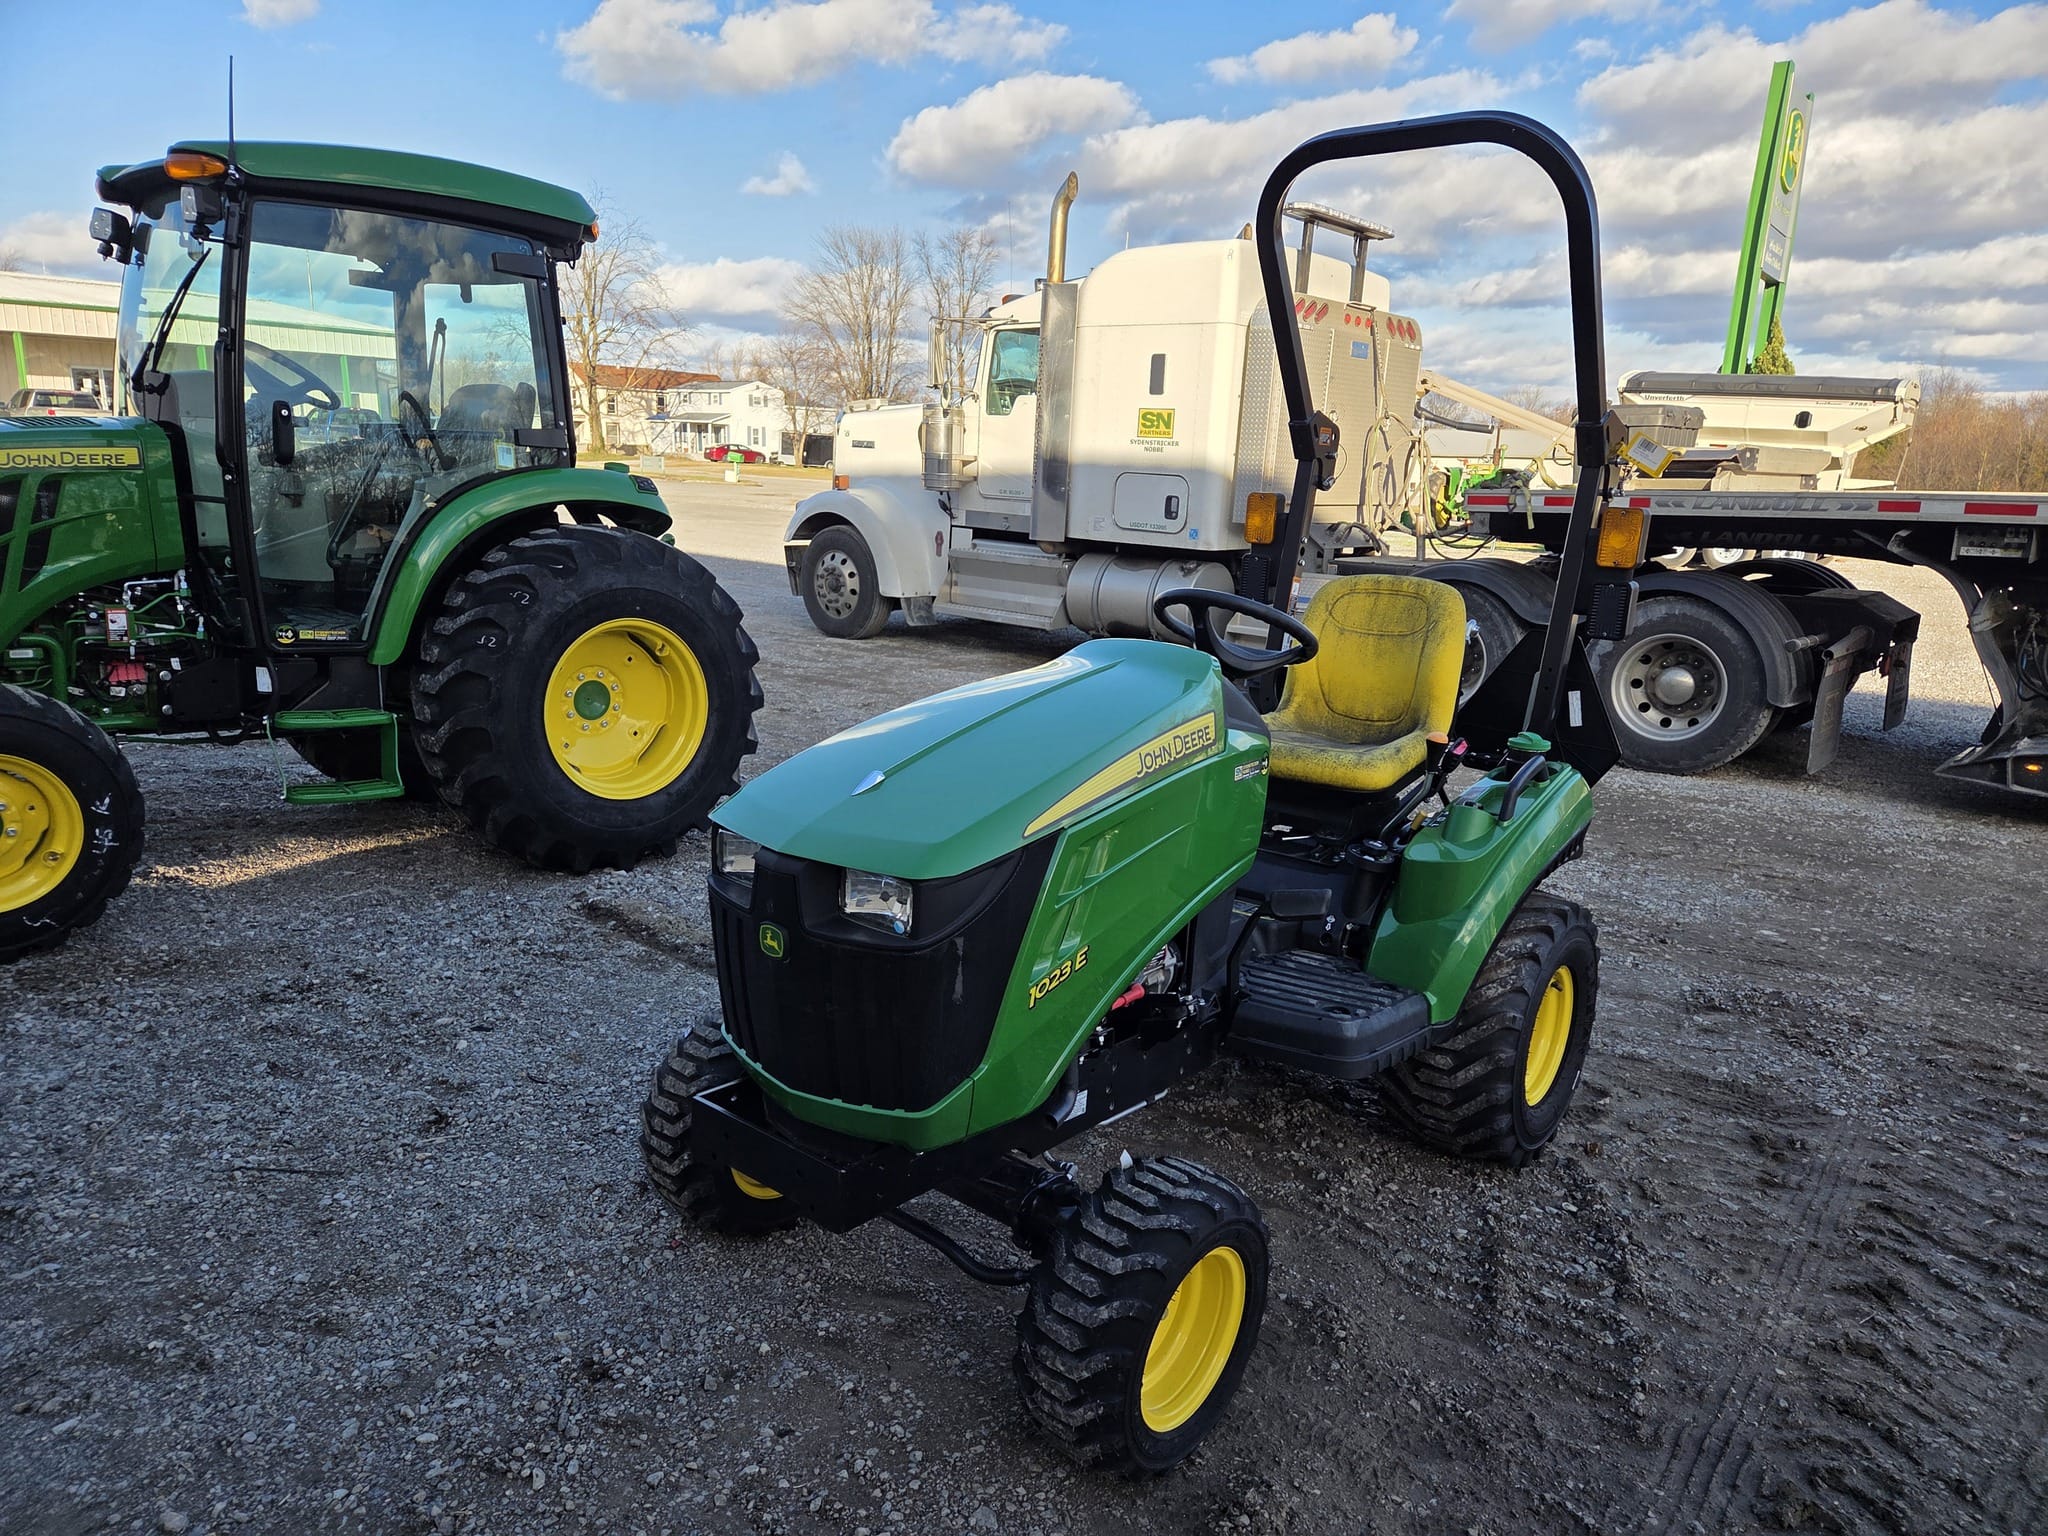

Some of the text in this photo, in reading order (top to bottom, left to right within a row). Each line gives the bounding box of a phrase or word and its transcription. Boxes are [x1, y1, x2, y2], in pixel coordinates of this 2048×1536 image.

[1141, 411, 1173, 429] SN
[1129, 439, 1180, 447] SYDENSTRICKER
[1, 451, 126, 466] JOHN DEERE
[1692, 496, 1829, 512] LANDOLL
[1700, 530, 1823, 546] LANDOLL
[1136, 725, 1212, 776] JOHN DEERE
